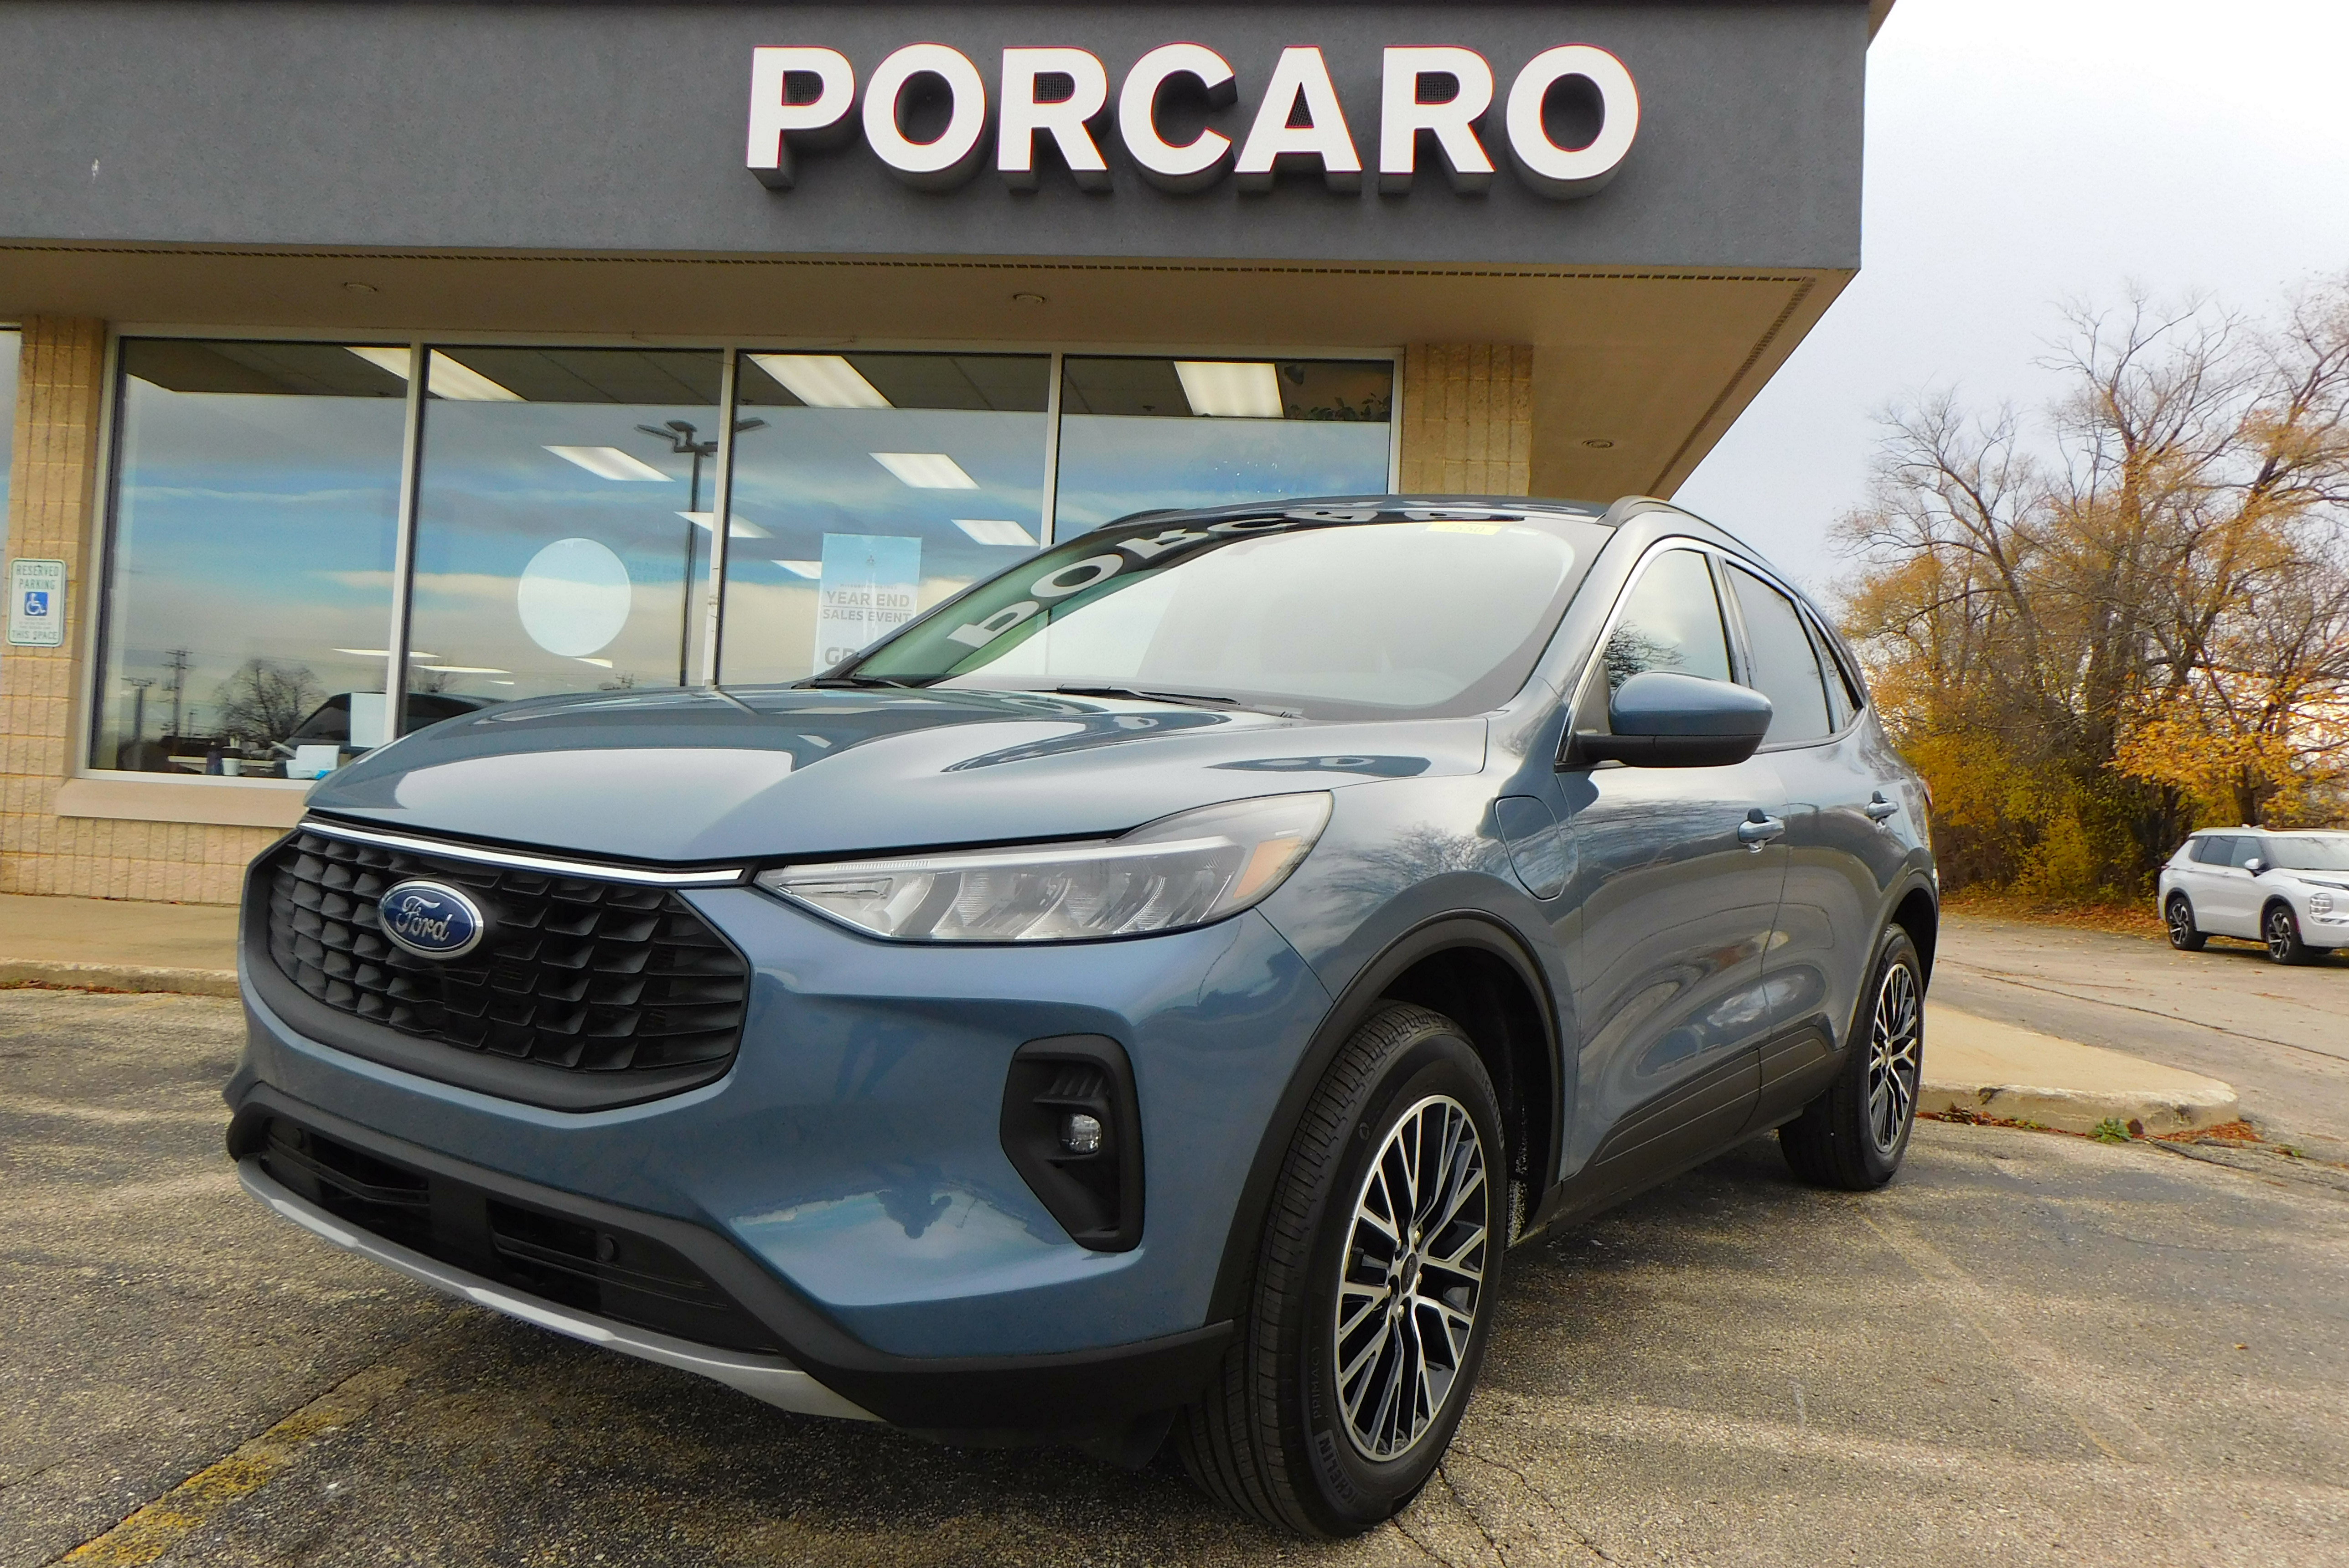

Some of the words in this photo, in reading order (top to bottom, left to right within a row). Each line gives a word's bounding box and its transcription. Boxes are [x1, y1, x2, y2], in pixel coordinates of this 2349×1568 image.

[746, 42, 1640, 180] PORCARO
[16, 565, 59, 576] RESERVED
[18, 578, 55, 590] PARKING
[826, 591, 870, 606] YEAR
[876, 593, 910, 608] END
[823, 609, 864, 621] SALES
[868, 611, 911, 623] EVENT
[12, 630, 30, 639] THIS
[33, 630, 57, 640] SPACE
[396, 895, 453, 942] Ford
[1311, 1346, 1322, 1419] PRIMACY
[1318, 1436, 1358, 1504] ICHELIN
